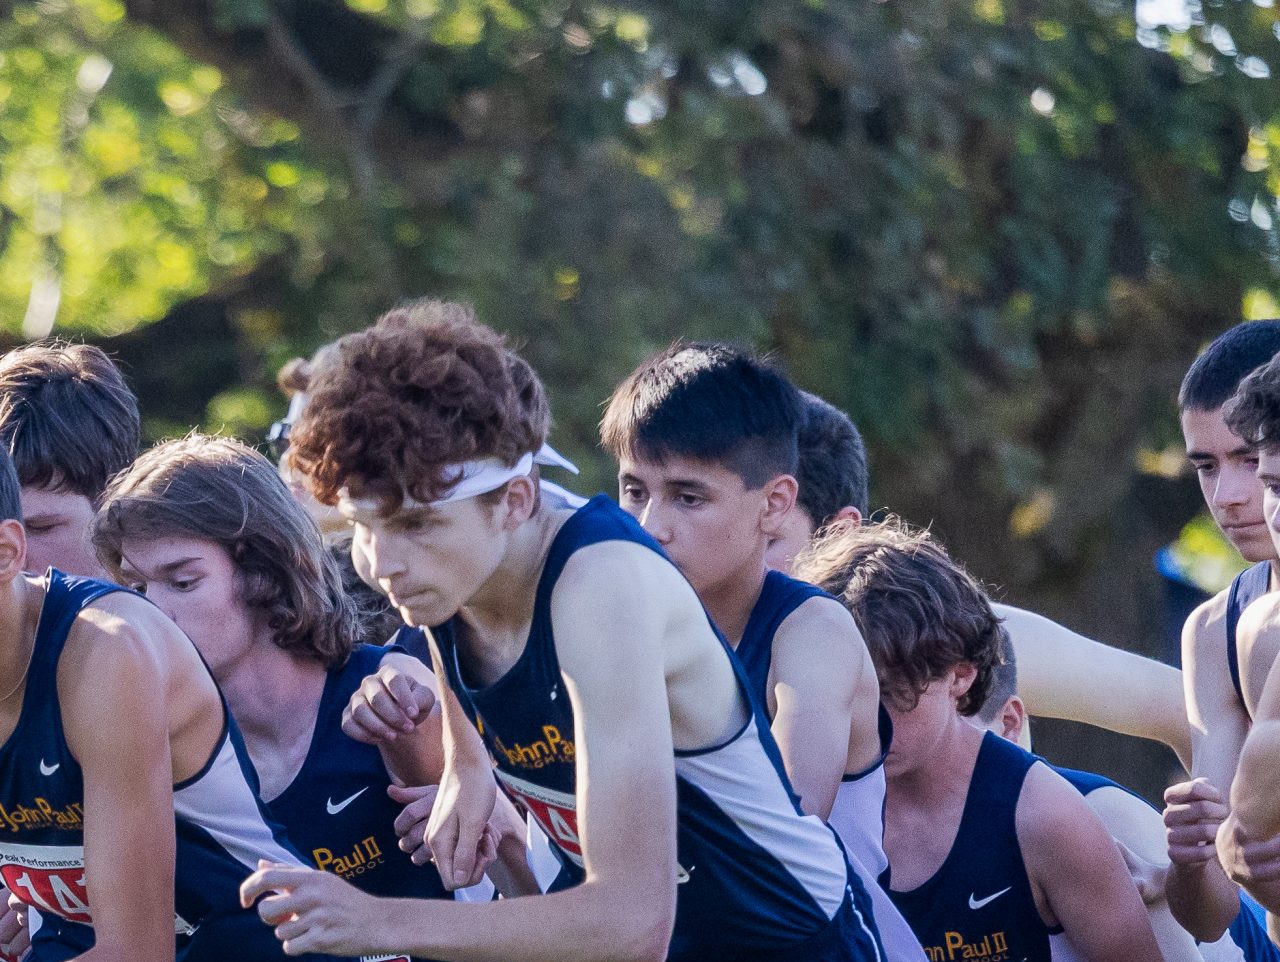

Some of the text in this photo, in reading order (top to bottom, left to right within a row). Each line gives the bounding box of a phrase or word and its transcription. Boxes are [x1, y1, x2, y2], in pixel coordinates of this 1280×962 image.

[20, 856, 82, 867] Performance
[312, 836, 383, 874] Paul II
[339, 857, 385, 880] HOOL
[945, 931, 992, 961] Paul
[992, 931, 1009, 953] II
